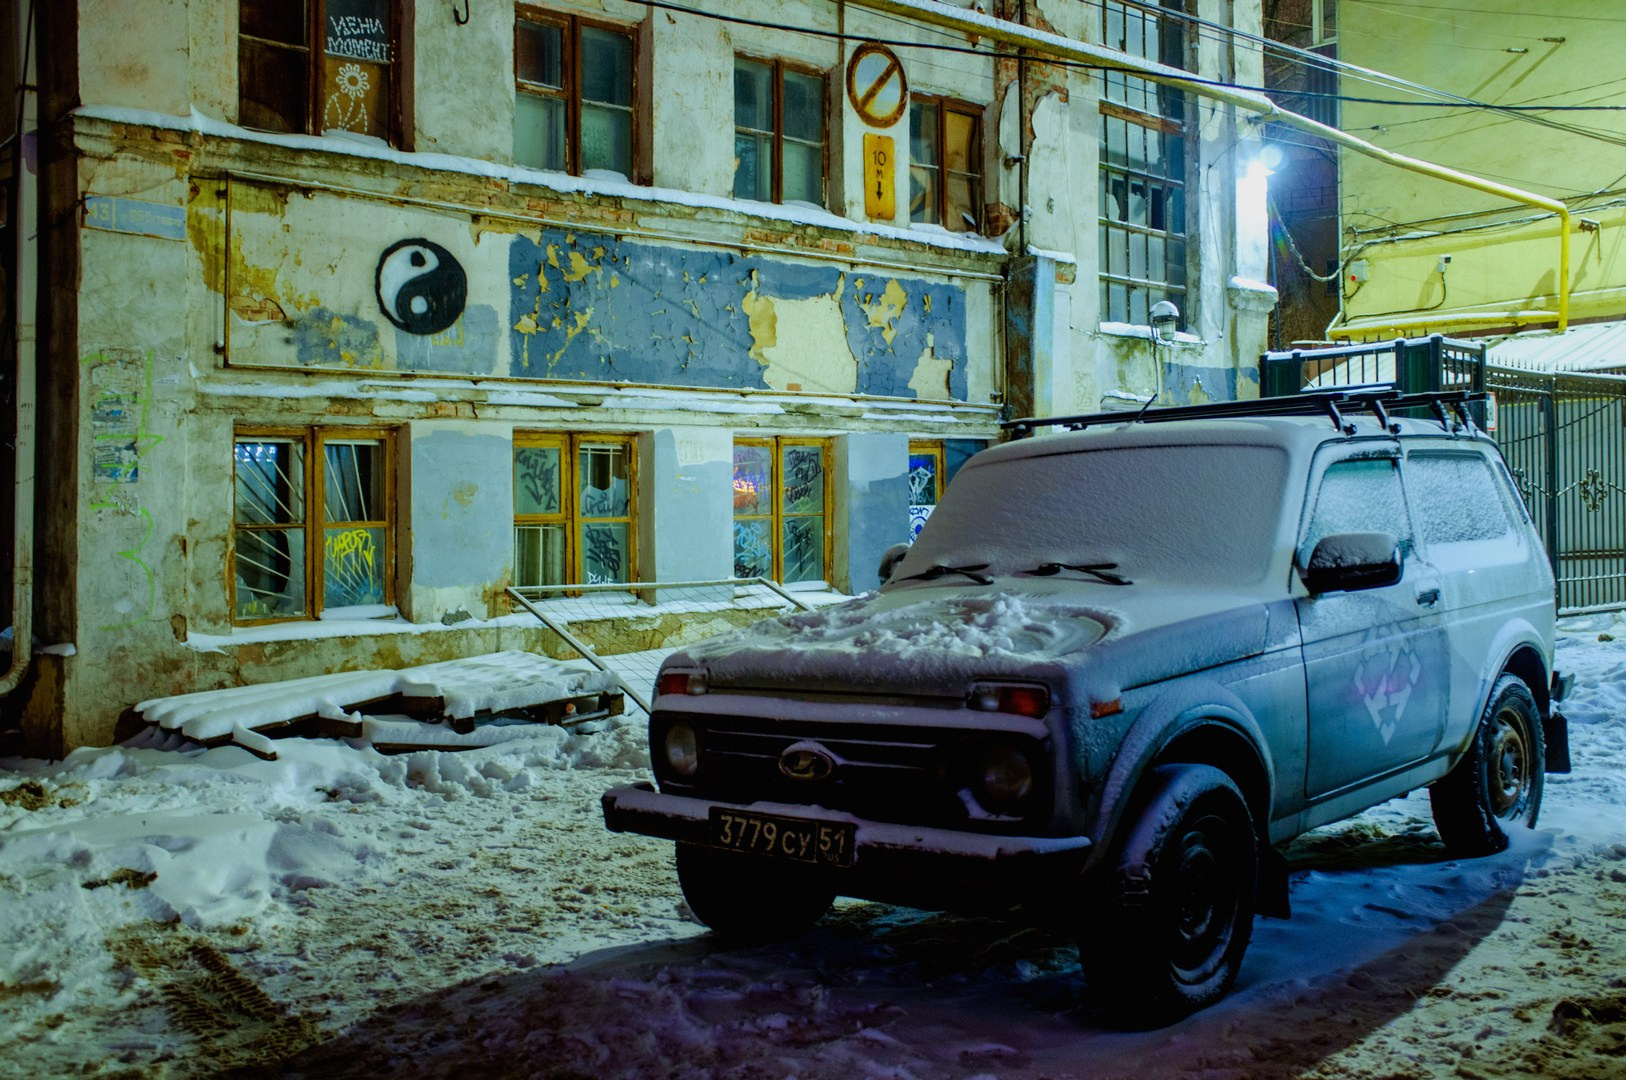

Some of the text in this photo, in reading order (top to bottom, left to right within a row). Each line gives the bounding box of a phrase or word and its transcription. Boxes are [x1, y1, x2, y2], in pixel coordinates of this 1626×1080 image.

[327, 36, 390, 61] МОМЕНТ
[873, 150, 887, 167] 10
[720, 814, 777, 851] 3779
[819, 827, 846, 854] 51
